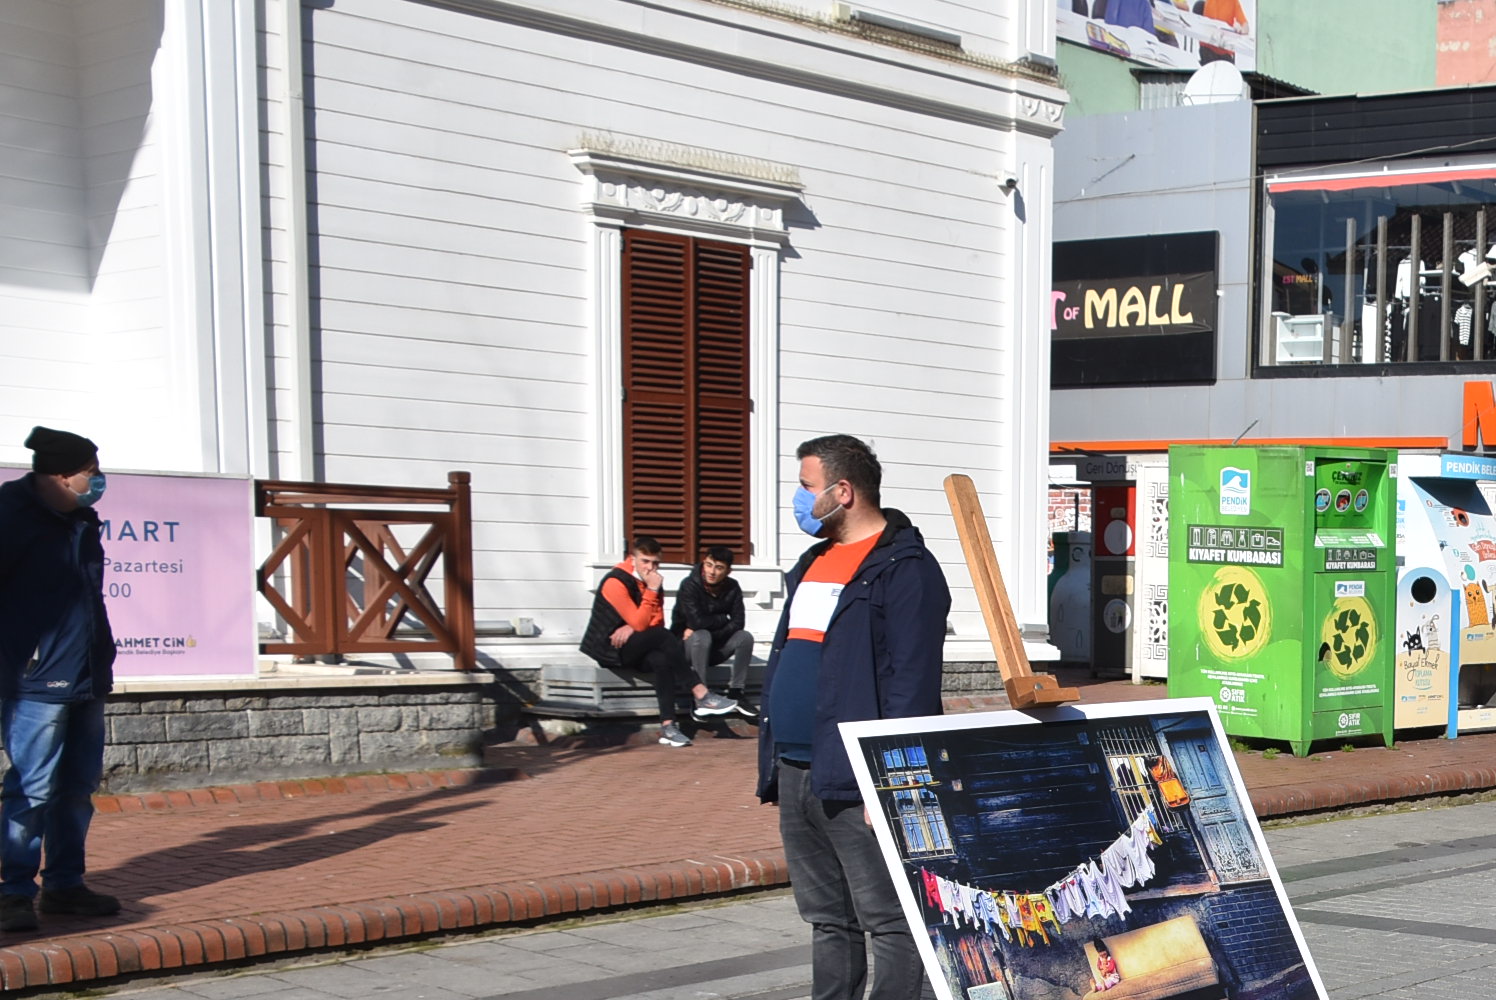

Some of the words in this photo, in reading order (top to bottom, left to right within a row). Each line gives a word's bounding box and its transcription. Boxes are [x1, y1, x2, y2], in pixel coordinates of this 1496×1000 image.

[1064, 307, 1081, 320] OF
[1084, 283, 1193, 329] MALL
[1446, 461, 1480, 473] PENDİK
[1189, 548, 1226, 561] KIYAFET
[1227, 549, 1282, 565] KUMBARASI
[114, 637, 160, 648] AHMET
